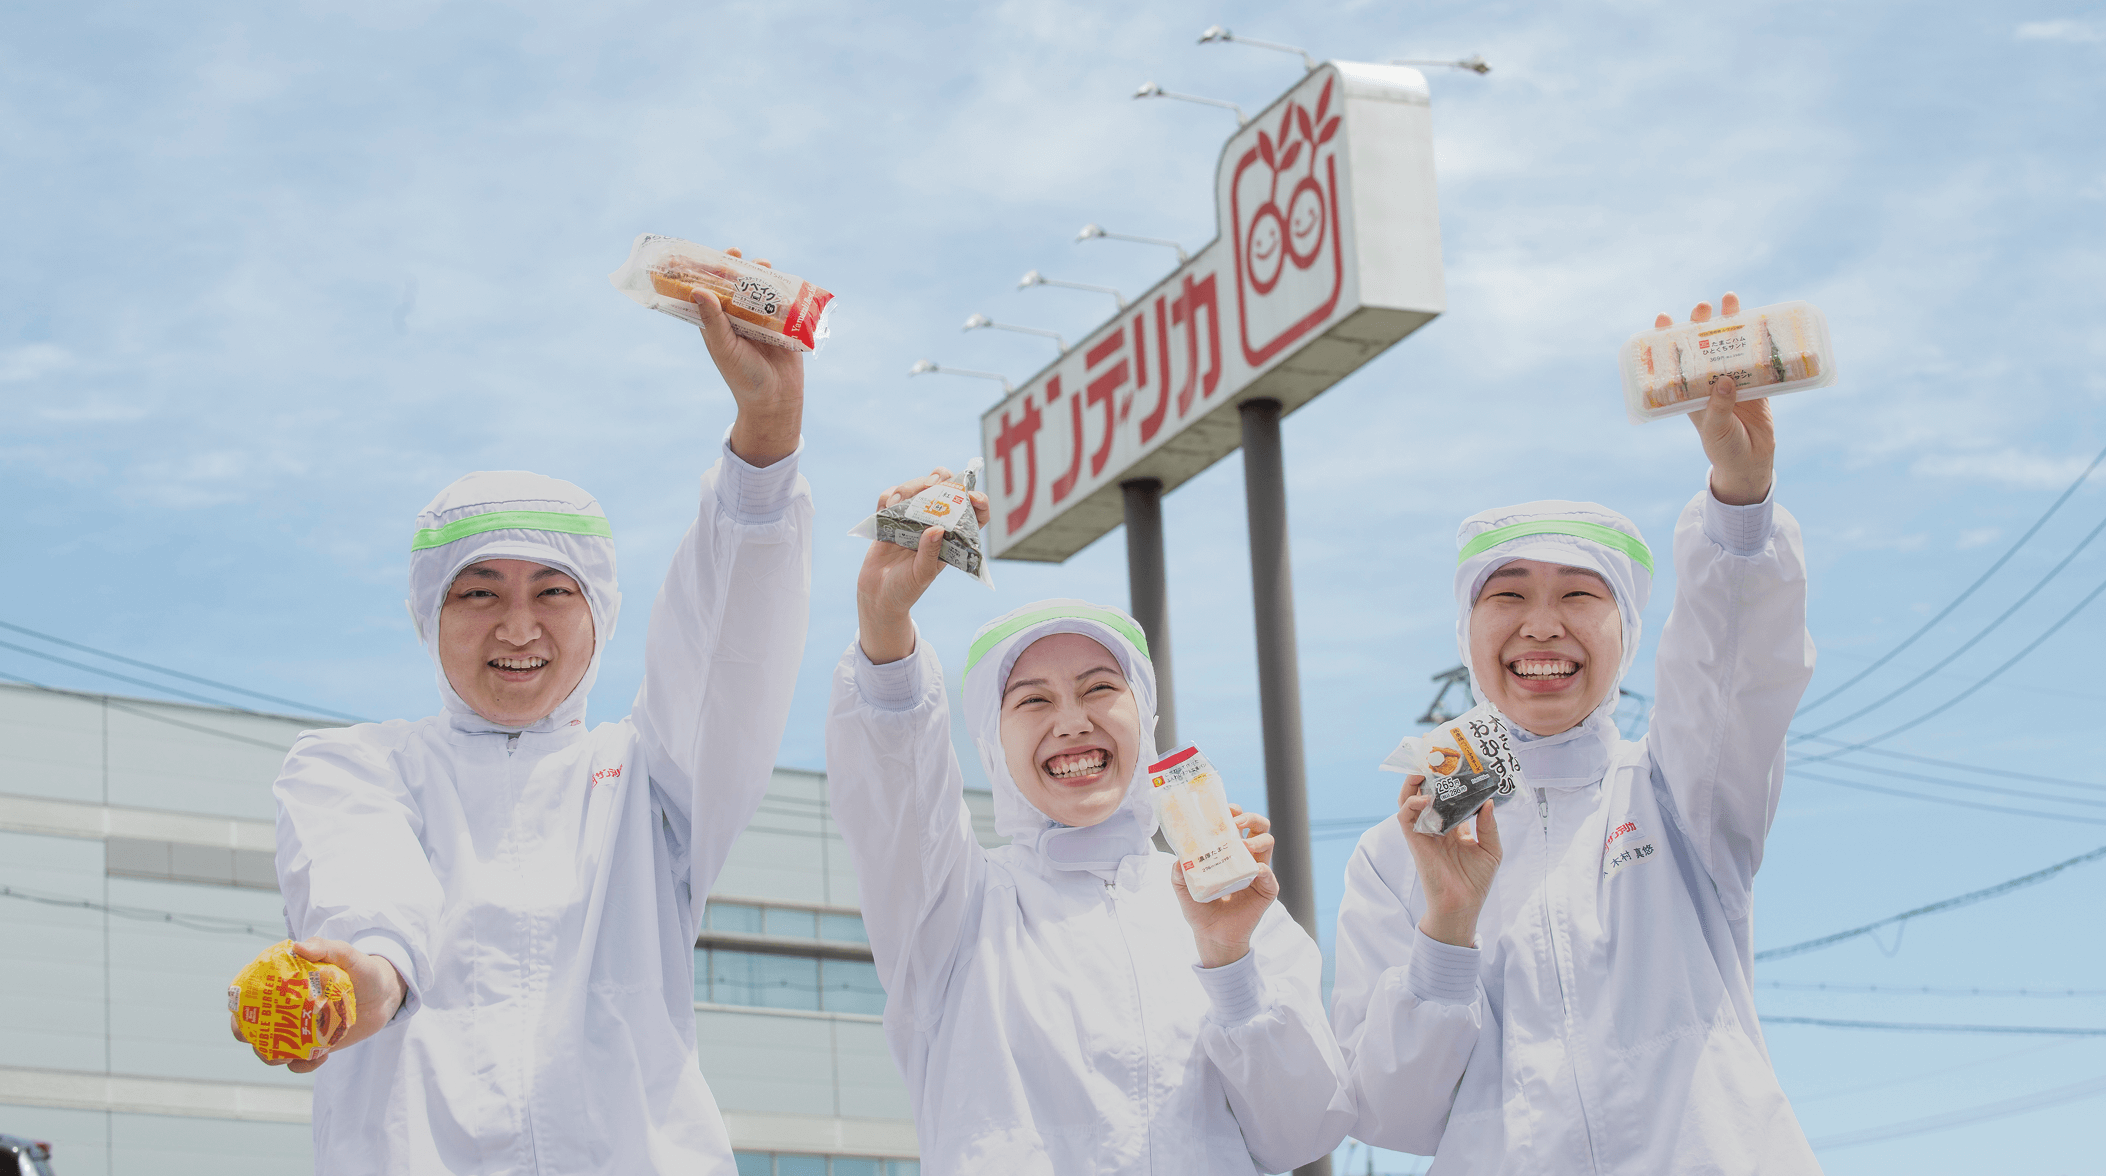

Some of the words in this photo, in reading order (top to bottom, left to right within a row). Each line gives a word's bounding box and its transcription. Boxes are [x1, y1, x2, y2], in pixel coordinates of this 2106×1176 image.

[739, 281, 777, 301] リベイク
[1703, 341, 1747, 355] ひとくちサンド
[1711, 336, 1746, 347] たまごハム
[994, 270, 1222, 537] サンデリカ
[1469, 719, 1516, 795] おむすび
[1436, 777, 1460, 793] 265円
[1610, 850, 1632, 868] 木村
[1633, 844, 1654, 859] 真悠
[261, 974, 275, 1016] BURGER
[301, 1010, 312, 1036] チーズ
